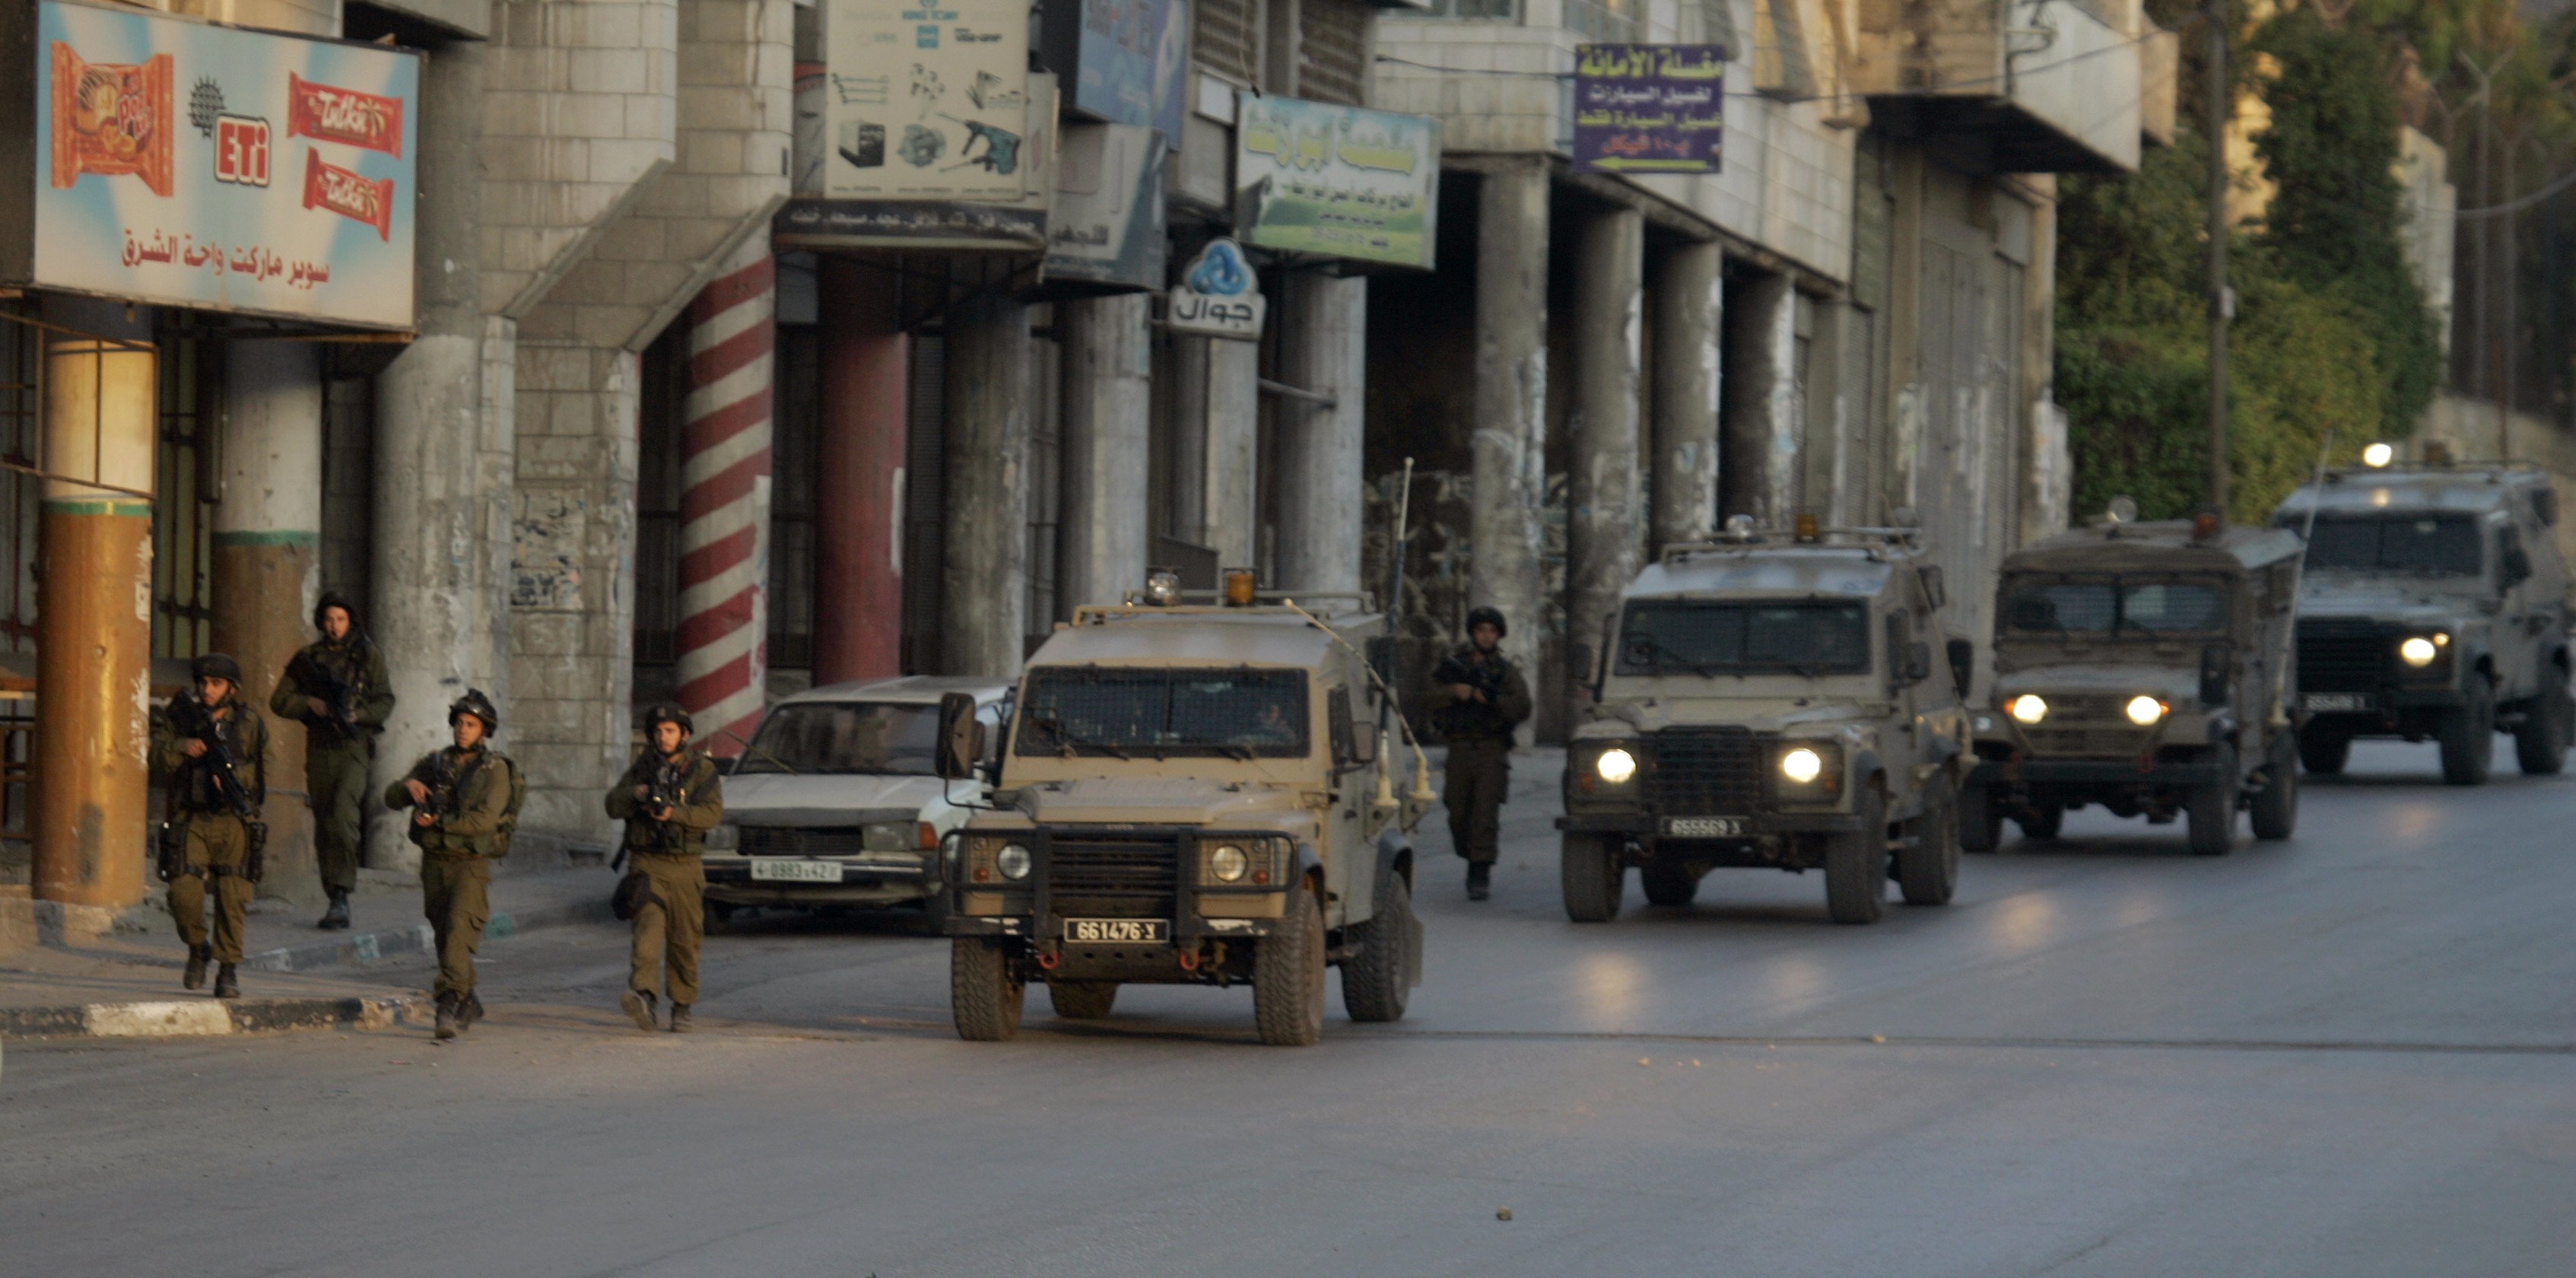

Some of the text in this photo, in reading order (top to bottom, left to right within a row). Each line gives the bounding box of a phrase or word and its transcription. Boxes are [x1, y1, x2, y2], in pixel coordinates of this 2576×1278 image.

[122, 227, 178, 268] الشرق
[183, 234, 224, 276] واحة
[230, 245, 282, 282] ماركت
[1176, 297, 1253, 329] جوال
